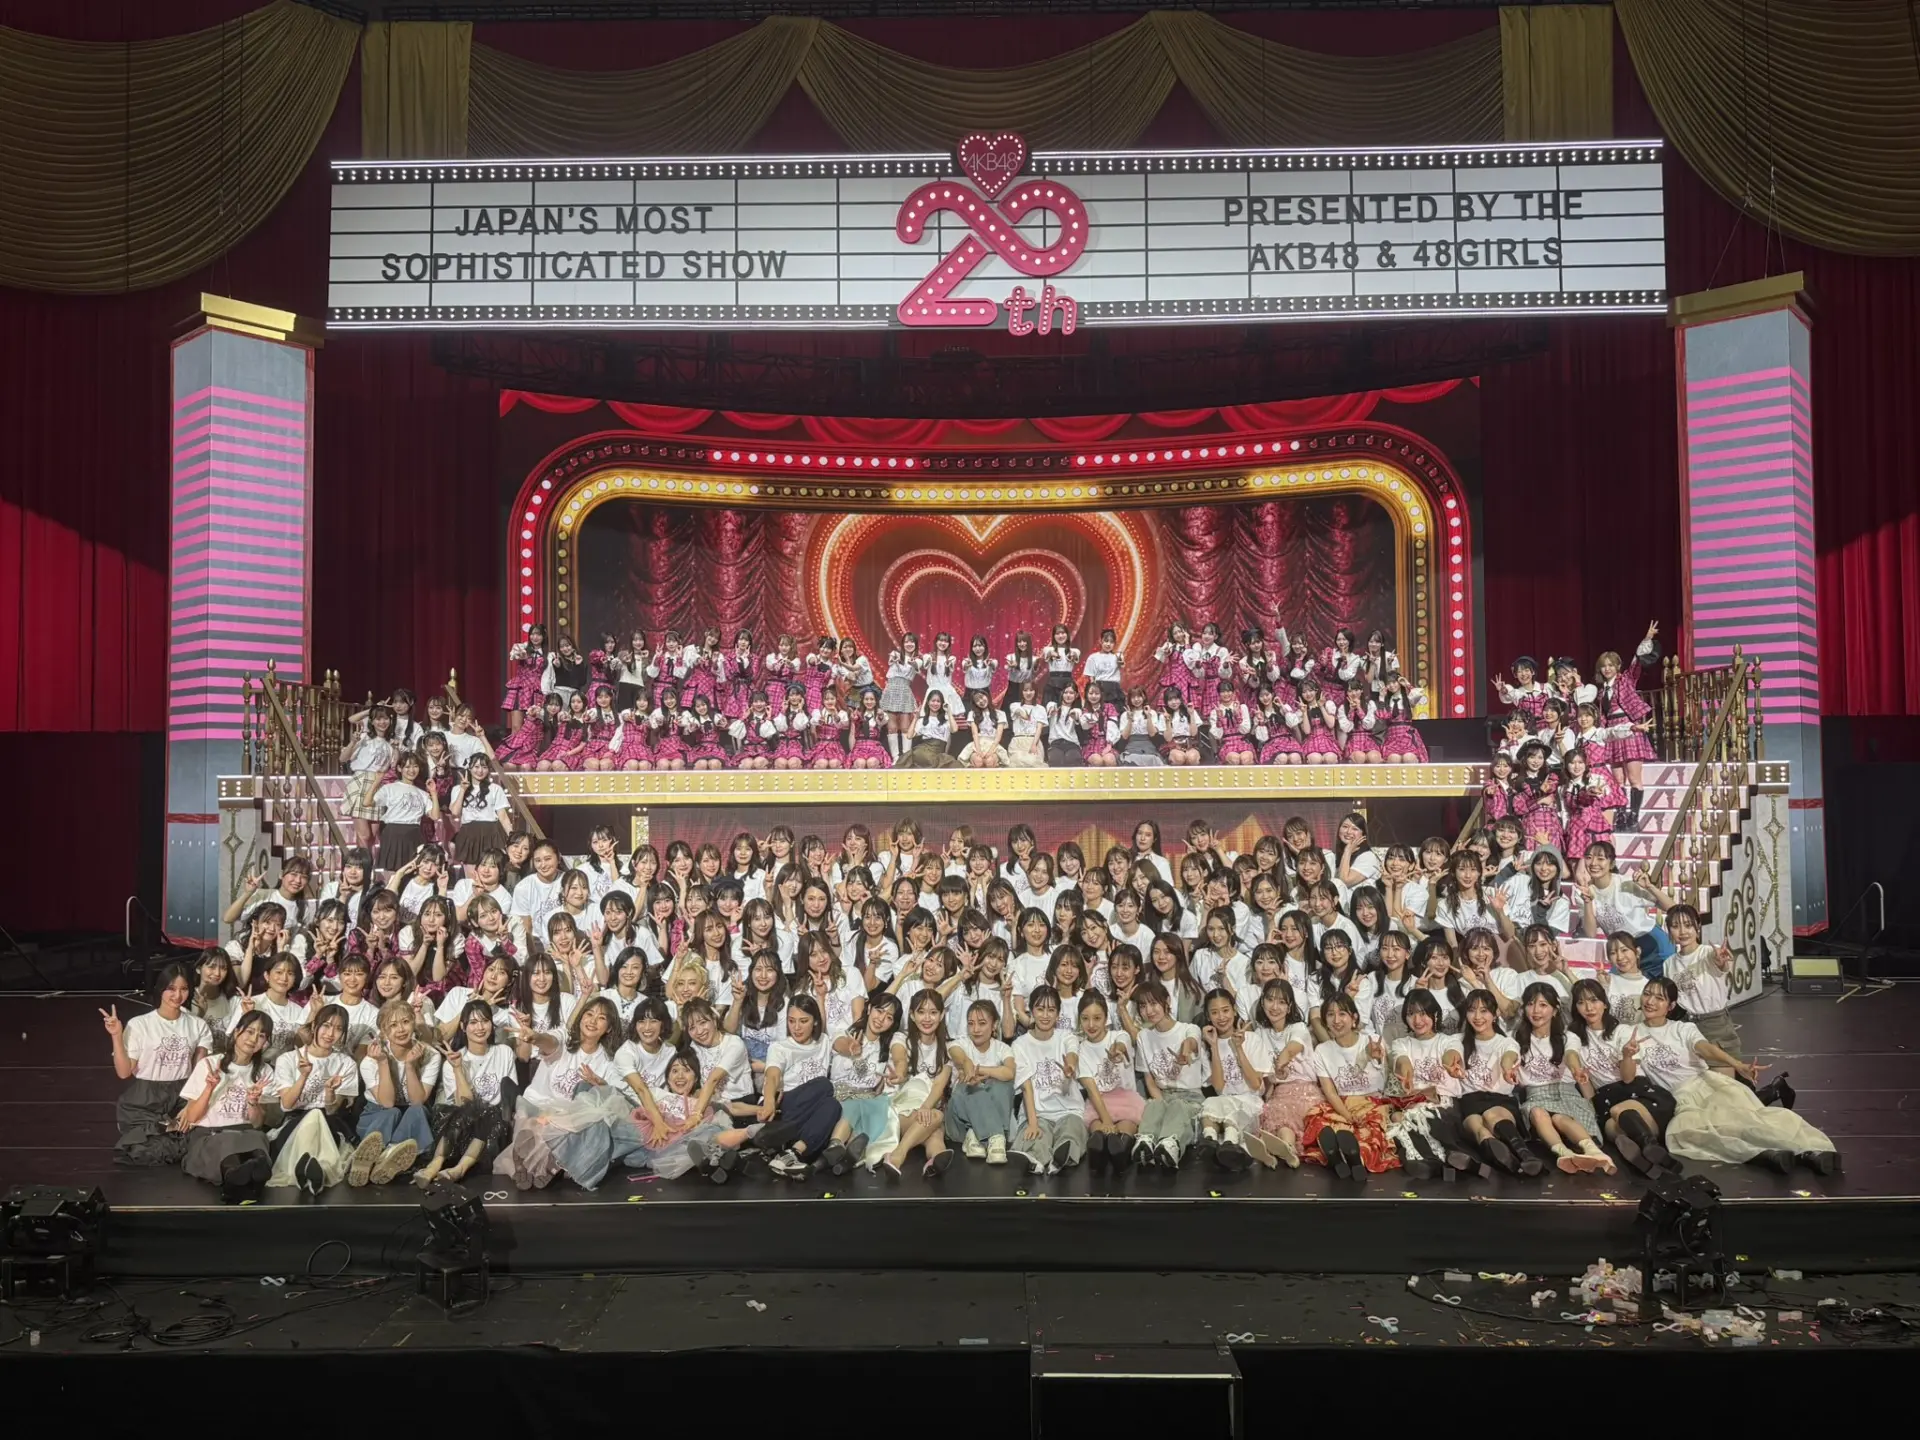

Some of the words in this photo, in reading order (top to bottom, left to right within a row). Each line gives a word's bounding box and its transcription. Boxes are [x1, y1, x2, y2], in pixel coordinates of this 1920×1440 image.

[965, 152, 1018, 171] AKB48
[455, 207, 598, 236] JAPAN'S
[615, 206, 713, 235] MOST
[1224, 193, 1438, 226] PRESENTED
[1455, 193, 1499, 222] BY
[1513, 191, 1583, 221] THE
[381, 250, 665, 280] SOPHISTICATED
[682, 250, 787, 279] SHOW
[1251, 241, 1359, 271] AKB48
[1376, 240, 1397, 268] &
[1413, 237, 1562, 267] 48GIRLS
